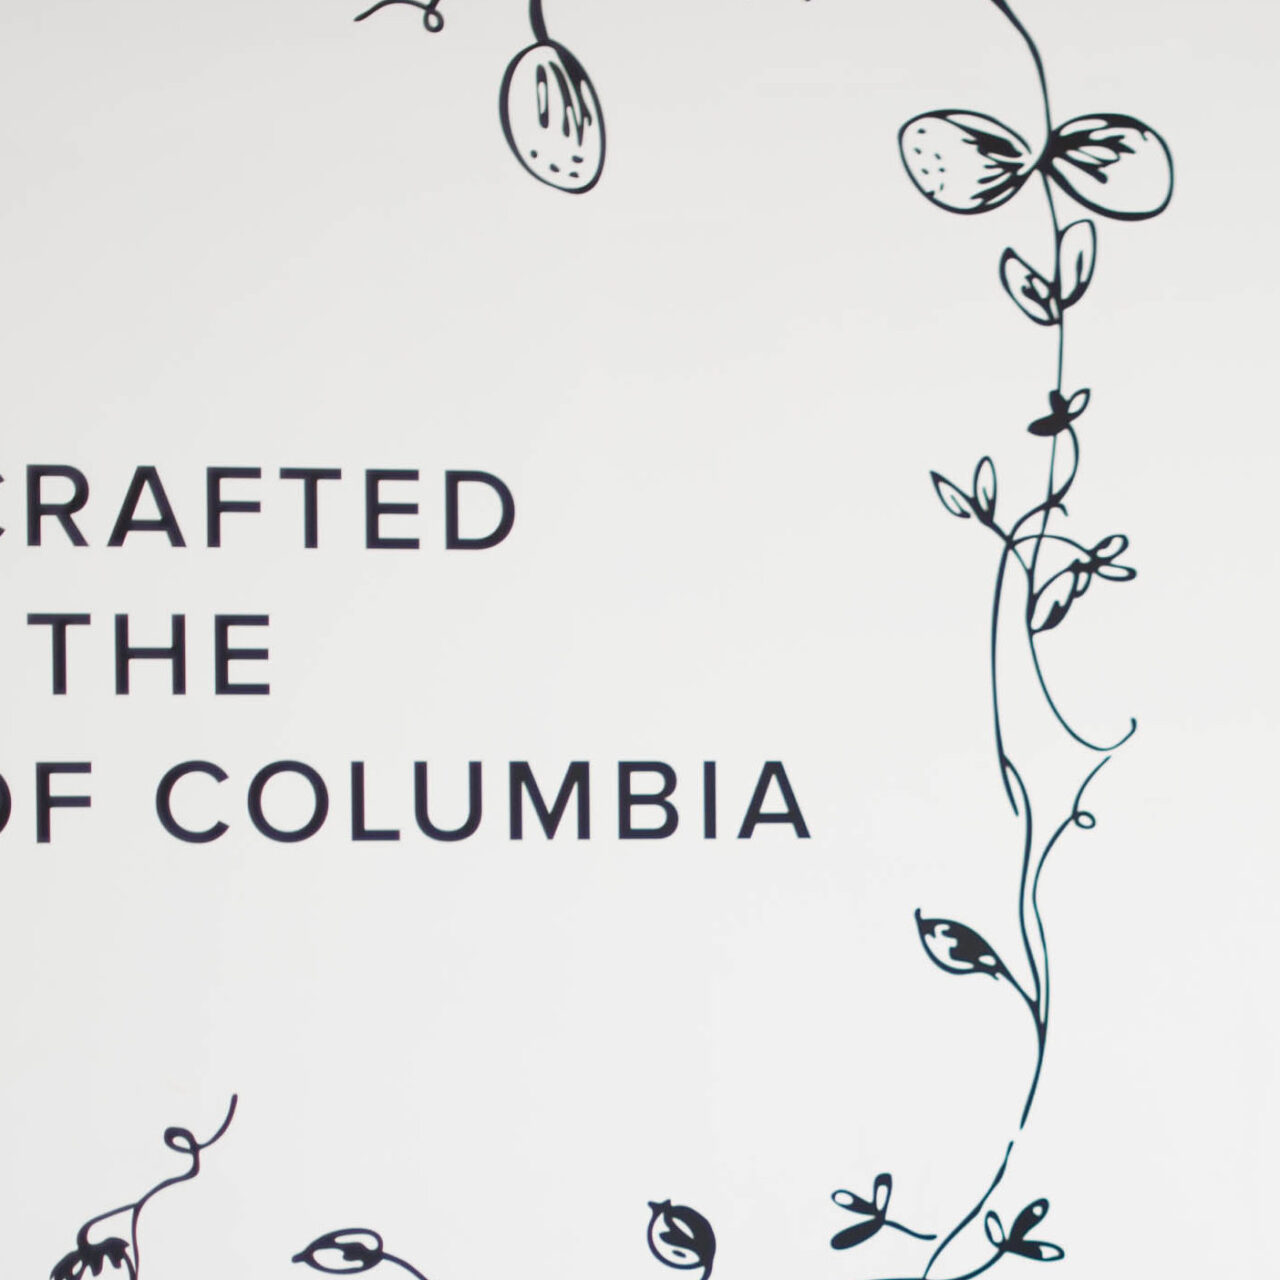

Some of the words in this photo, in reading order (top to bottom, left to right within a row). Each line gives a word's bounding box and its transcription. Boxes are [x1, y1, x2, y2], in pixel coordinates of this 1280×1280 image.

[0, 464, 516, 551] RAFTED
[27, 613, 270, 696] THE
[0, 761, 92, 844] F
[155, 760, 812, 844] COLUMBIA
